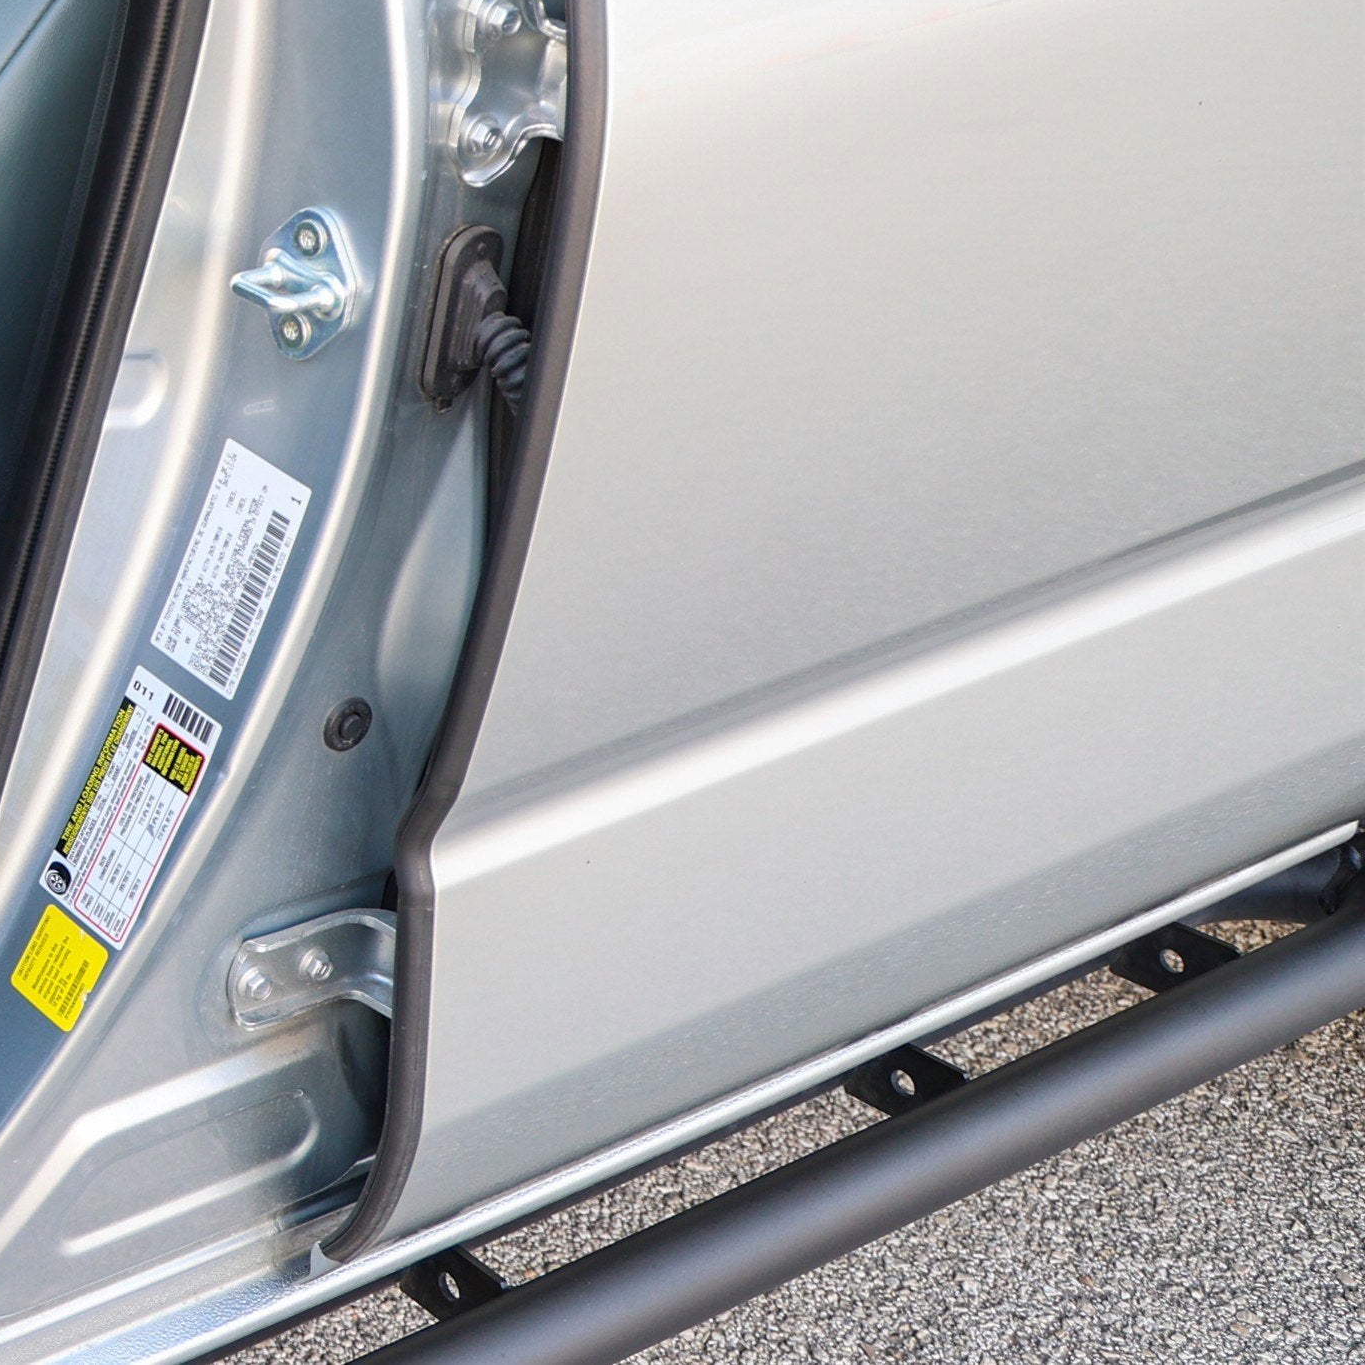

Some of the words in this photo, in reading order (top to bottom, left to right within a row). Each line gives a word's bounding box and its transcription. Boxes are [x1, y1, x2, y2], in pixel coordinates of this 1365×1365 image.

[173, 581, 183, 599] MOTOR
[62, 822, 74, 842] TIRE
[71, 803, 83, 823] AND
[79, 765, 100, 804] LOADING
[97, 708, 126, 766] INFORMATION
